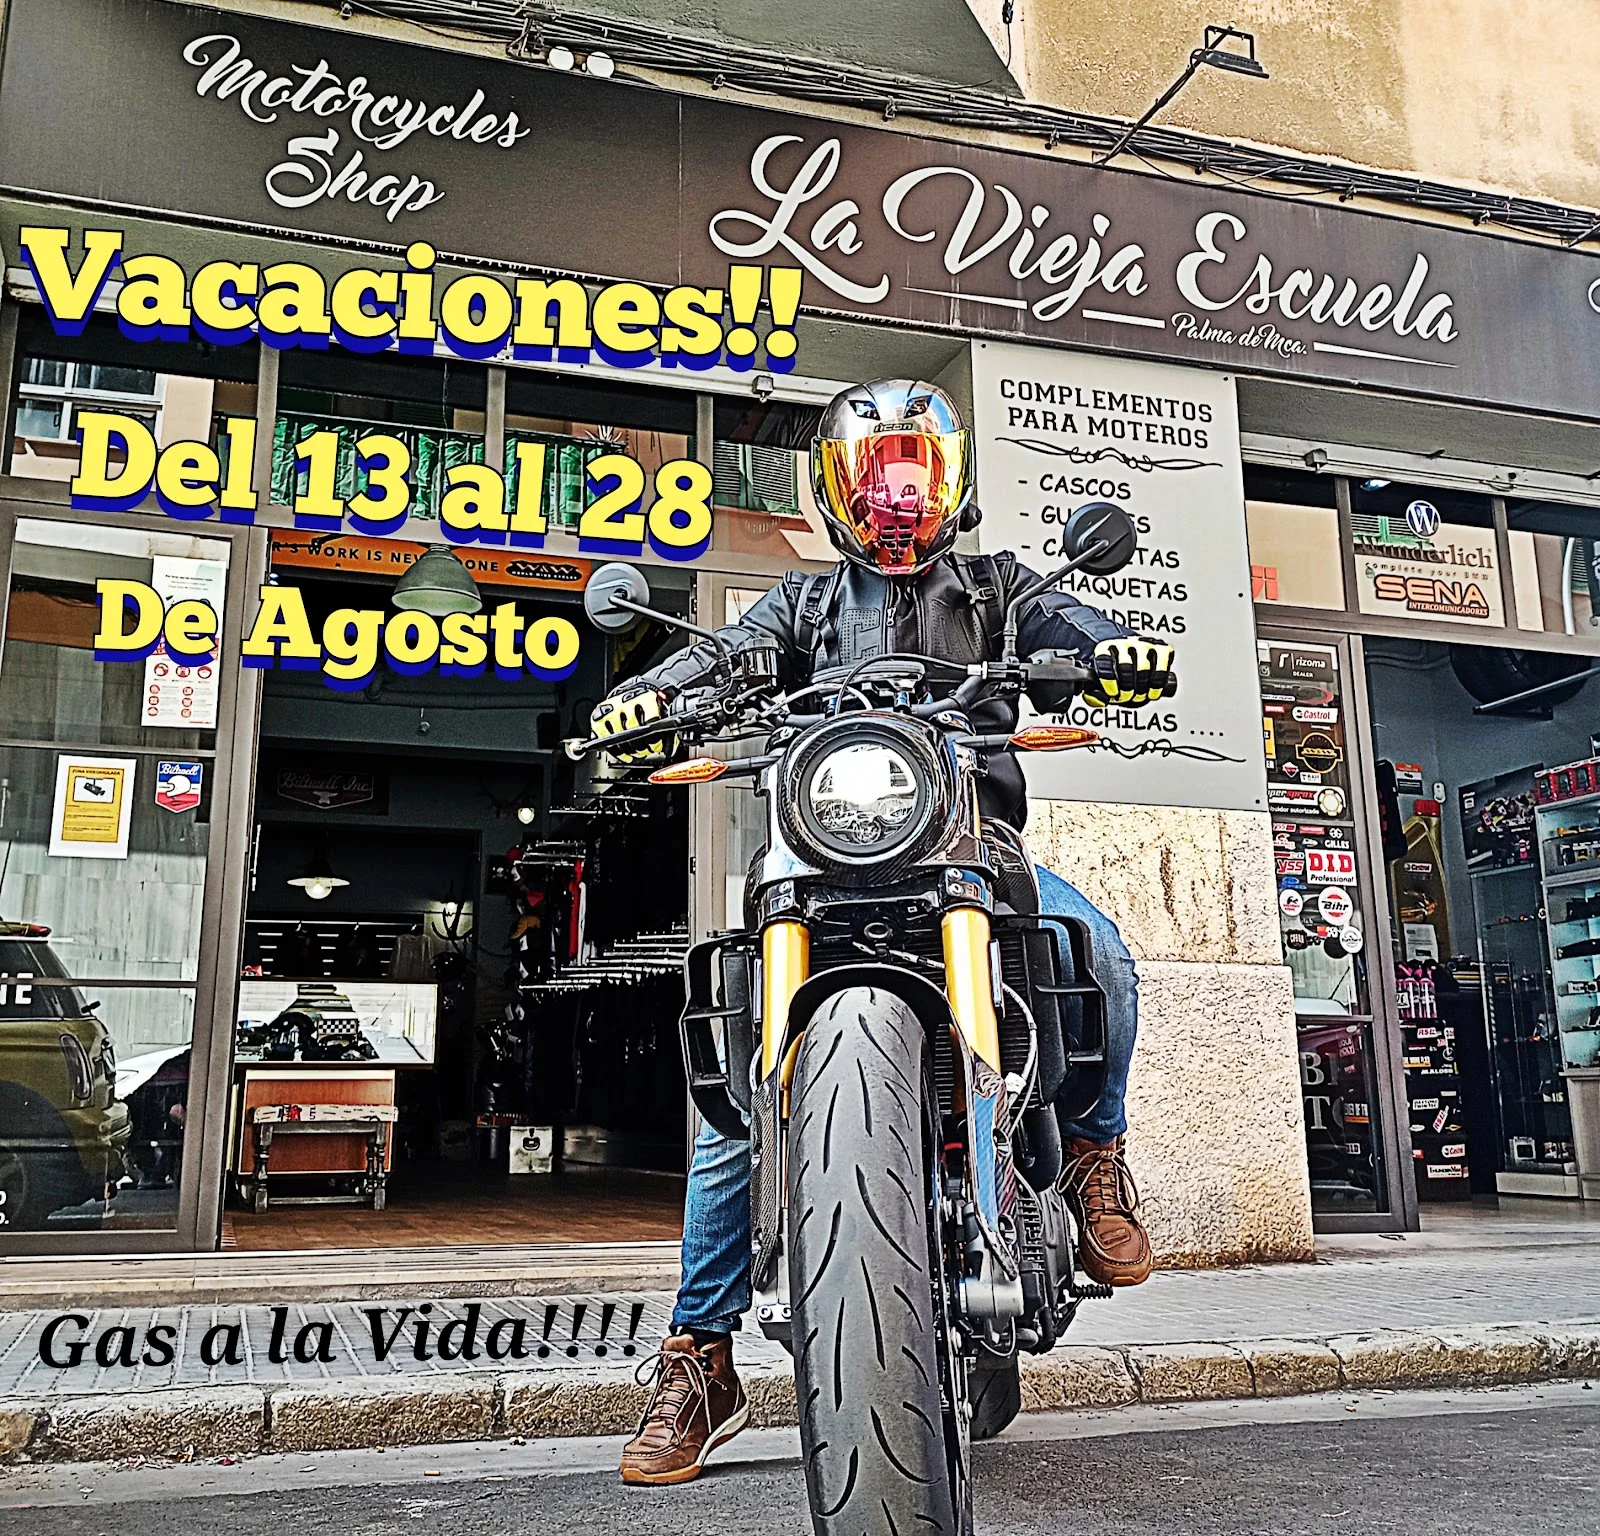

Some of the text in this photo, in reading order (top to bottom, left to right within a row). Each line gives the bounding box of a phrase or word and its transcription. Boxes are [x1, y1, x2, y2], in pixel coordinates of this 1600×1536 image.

[183, 34, 530, 150] Motorcycles
[265, 127, 445, 222] Shop
[709, 134, 1459, 344] La Vieja Escuela
[1171, 312, 1237, 345] Palma
[1238, 325, 1263, 347] de
[1000, 378, 1213, 423] COMPLEMENTOS
[1008, 406, 1209, 449] PARA MOTEROS
[1040, 474, 1132, 500] CASCOS
[308, 540, 360, 561] WORK
[367, 549, 383, 563] IS
[390, 552, 421, 565] NEV
[461, 558, 499, 572] ONE
[1375, 574, 1489, 608] SENA
[1408, 601, 1489, 616] INTERCOMUNICADORES
[1295, 656, 1327, 668] rizoma
[1303, 710, 1331, 720] Castrol
[1268, 789, 1315, 799] persprox
[1310, 874, 1354, 883] Professional
[1321, 900, 1349, 911] Bihr
